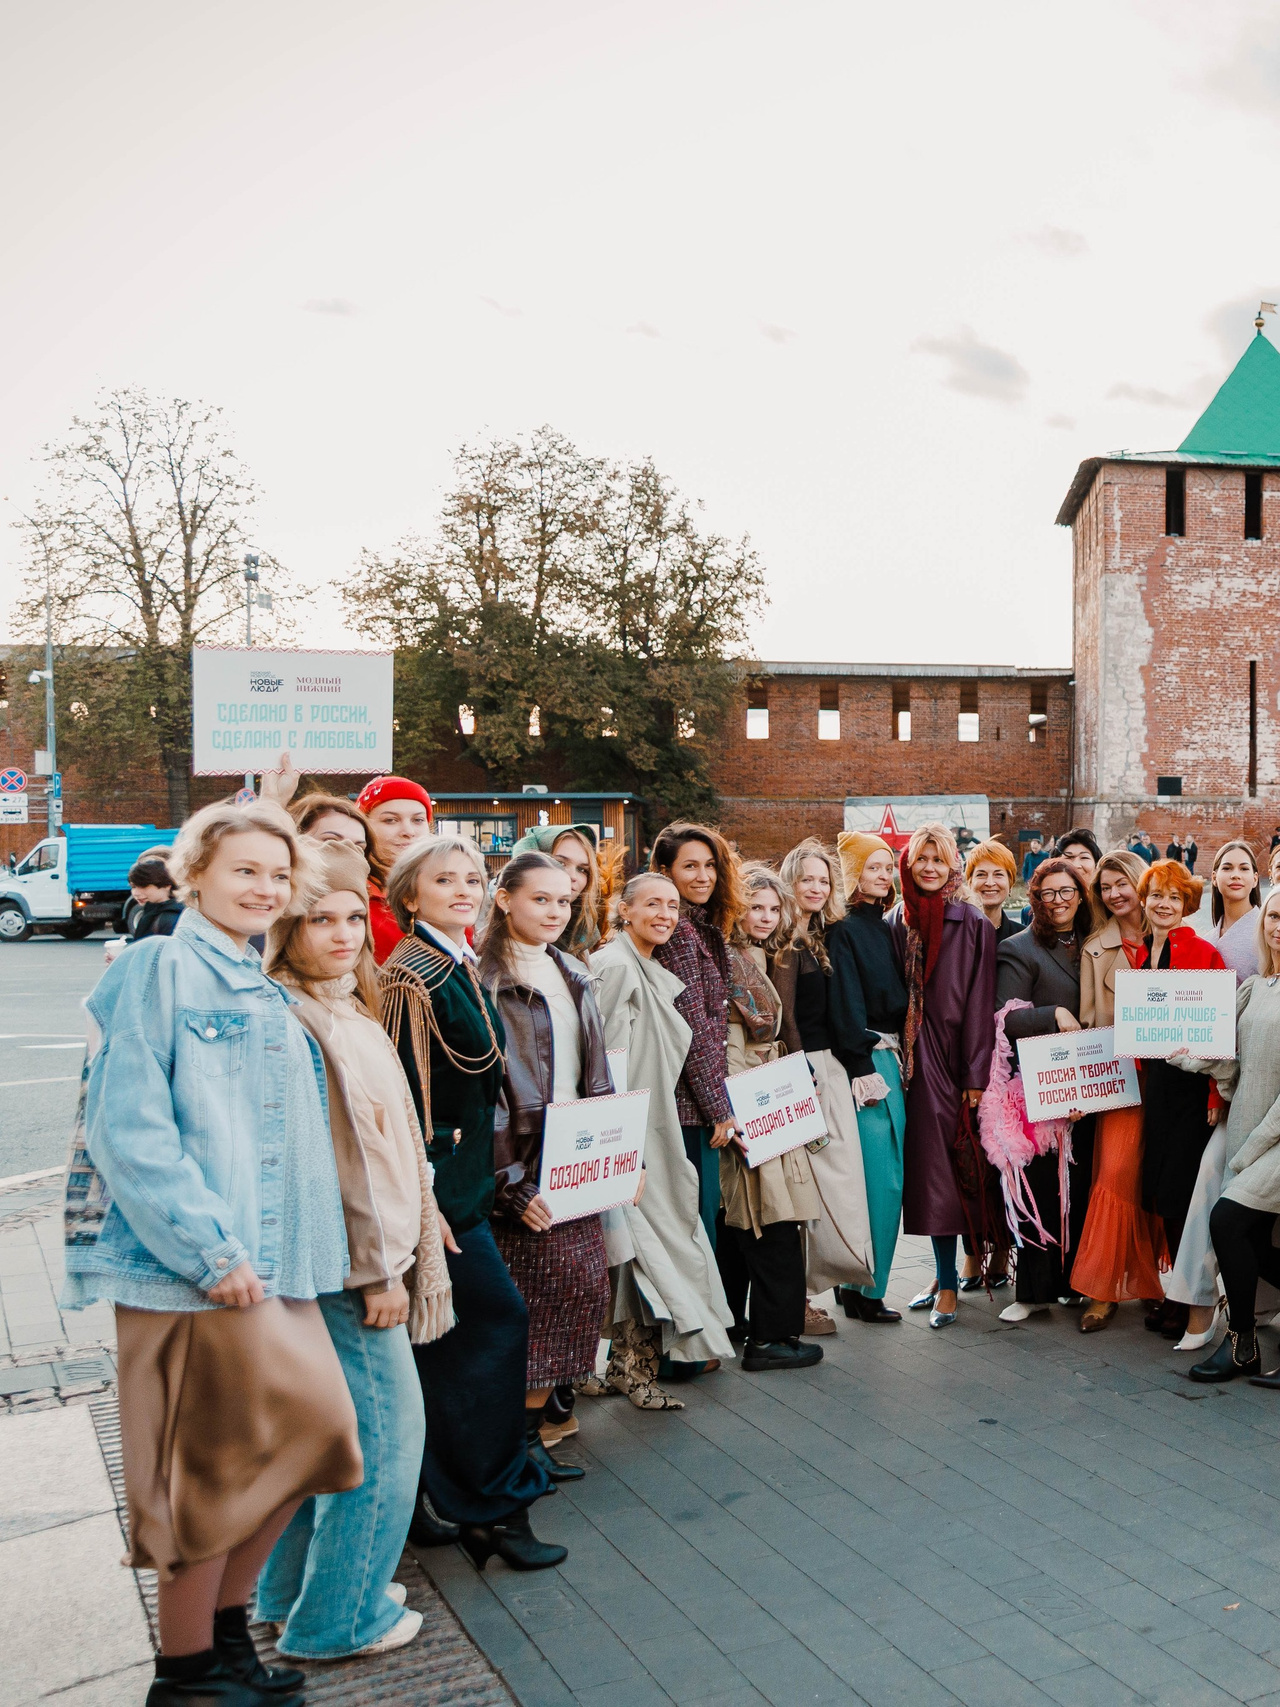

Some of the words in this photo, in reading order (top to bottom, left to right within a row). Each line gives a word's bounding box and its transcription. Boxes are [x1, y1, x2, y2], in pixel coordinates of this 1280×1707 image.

[296, 676, 341, 684] МОДНЫЙ
[217, 703, 288, 725] СДЕЛАНО
[294, 704, 303, 722] В
[310, 704, 372, 726] РОССИИ,
[212, 730, 281, 752] СДЕЛАНО
[288, 730, 297, 749] С
[303, 730, 377, 749] ЛЮБОВЬЮ
[1122, 1004, 1170, 1021] ВЫБИРАЙ
[1173, 1007, 1216, 1021] ЛУЧШЕЕ
[1136, 1025, 1183, 1042] ВЫБИРАЙ
[1187, 1026, 1213, 1042] СВОЁ
[1037, 1067, 1076, 1086] РОССИЯ
[1080, 1060, 1122, 1079] ТВОРИТ,
[1038, 1087, 1078, 1106] РОССИЯ
[1081, 1078, 1126, 1098] СОЗДАЁТ
[745, 1109, 786, 1140] СОЗДАНО
[785, 1106, 794, 1123] В
[793, 1097, 816, 1120] НИНО
[549, 1158, 600, 1191] СОЗДАНО
[603, 1156, 610, 1179] В
[613, 1150, 638, 1177] НИНО
